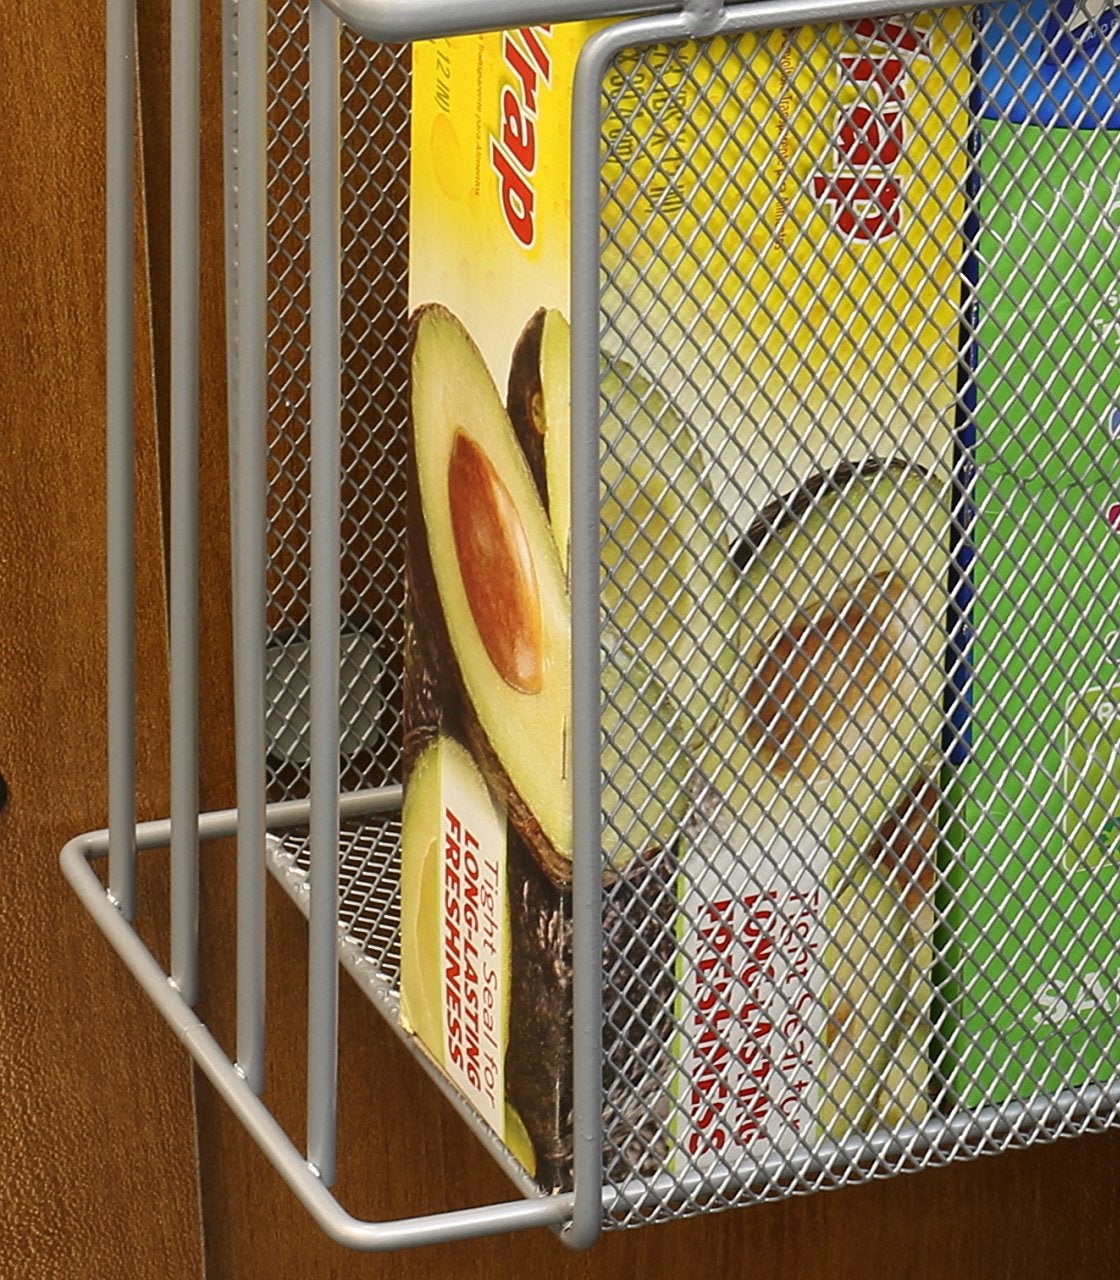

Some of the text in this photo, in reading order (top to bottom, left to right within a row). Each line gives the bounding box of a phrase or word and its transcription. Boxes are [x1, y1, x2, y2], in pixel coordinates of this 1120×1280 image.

[812, 18, 932, 246] rap
[445, 806, 466, 1073] FRESHNESS
[463, 828, 482, 1094] LONG-LASTING
[480, 847, 499, 1112] Tight Seal for
[688, 898, 734, 1157] FRESHNESS
[734, 889, 778, 1149] LONG-LASTING
